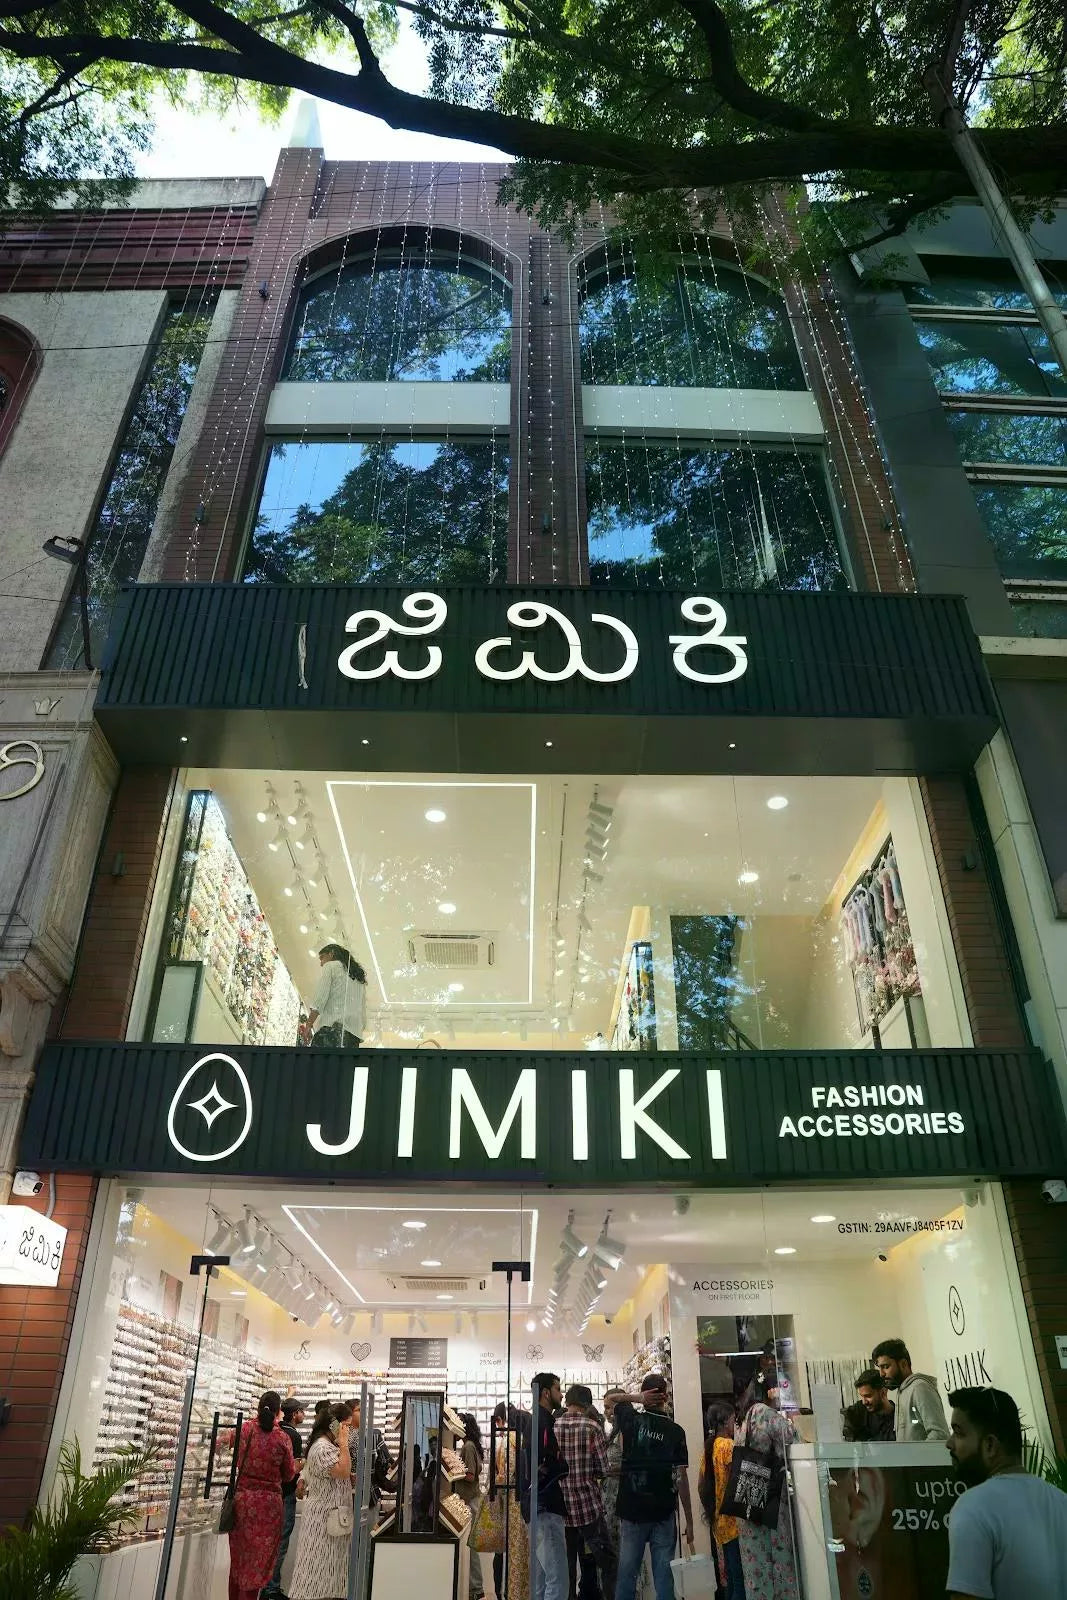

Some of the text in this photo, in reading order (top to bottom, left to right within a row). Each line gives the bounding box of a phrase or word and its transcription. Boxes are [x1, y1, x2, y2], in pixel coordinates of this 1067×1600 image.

[337, 591, 749, 684] ಜಿಮಿಕಿ
[811, 1084, 925, 1109] FASHION
[306, 1066, 727, 1161] JIMIKI
[778, 1111, 965, 1138] ACCESSORIES
[838, 1220, 964, 1234] GSTIN: 29AAVFJ8405F1ZV
[693, 1279, 774, 1291] ACCESSORIES
[915, 1477, 968, 1504] upto
[891, 1508, 940, 1530] 25%
